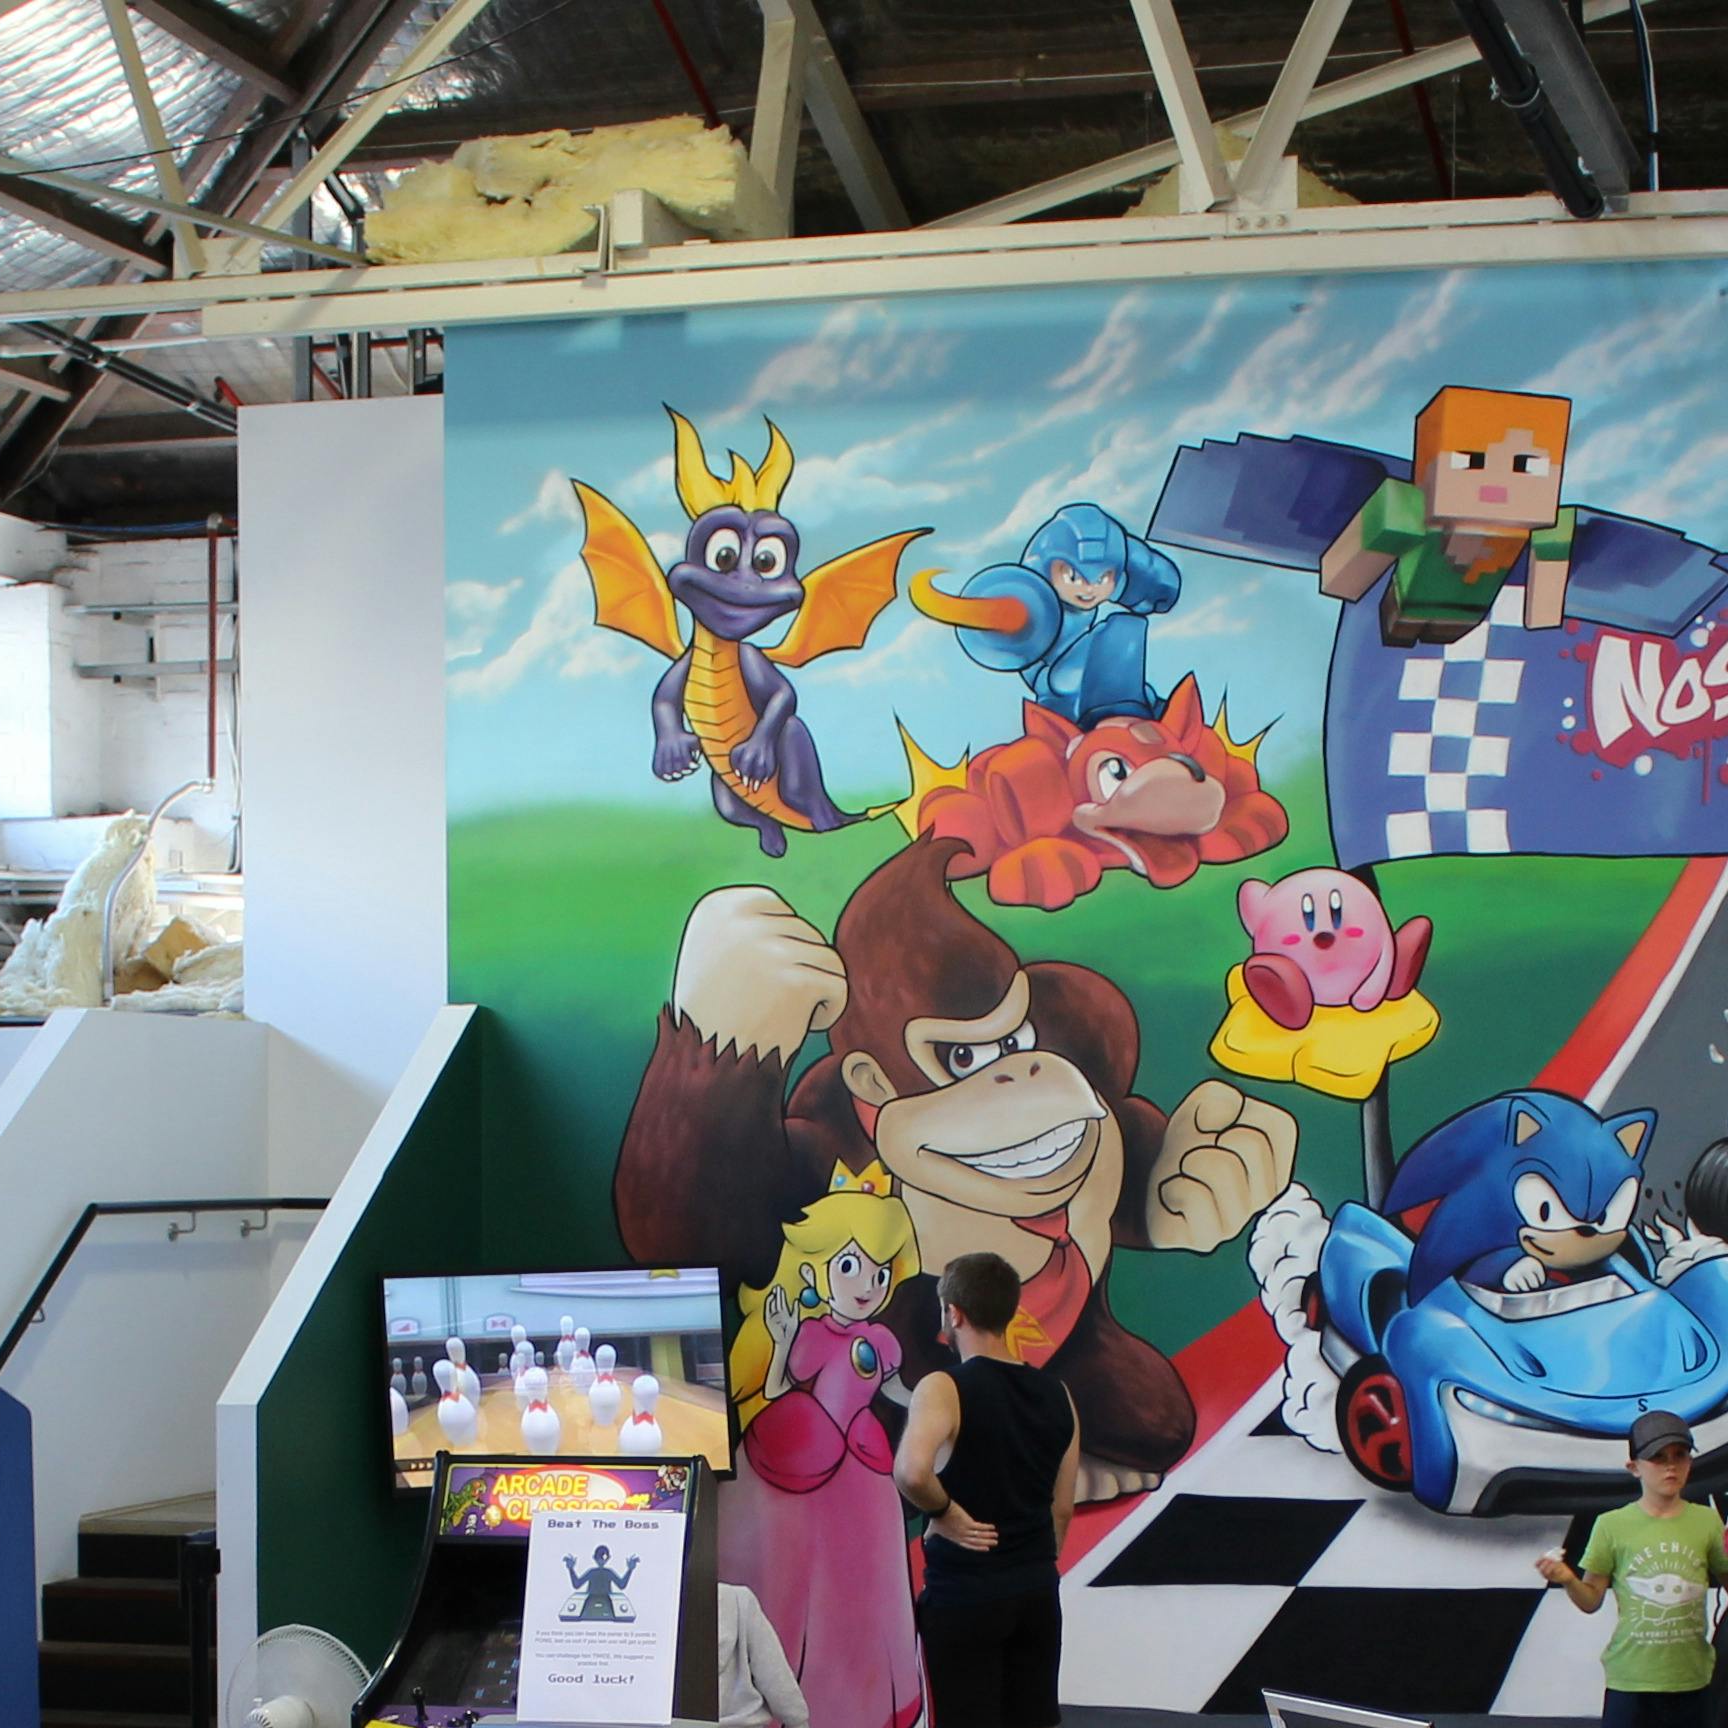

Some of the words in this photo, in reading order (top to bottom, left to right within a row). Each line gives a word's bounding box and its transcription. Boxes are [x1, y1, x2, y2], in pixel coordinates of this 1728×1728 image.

[492, 1474, 588, 1496] ARCADE
[547, 1519, 582, 1529] Beat
[592, 1519, 617, 1529] The
[624, 1519, 660, 1530] Boss
[1628, 1545, 1654, 1572] THE
[547, 1673, 584, 1684] Good
[592, 1673, 635, 1685] luck!
